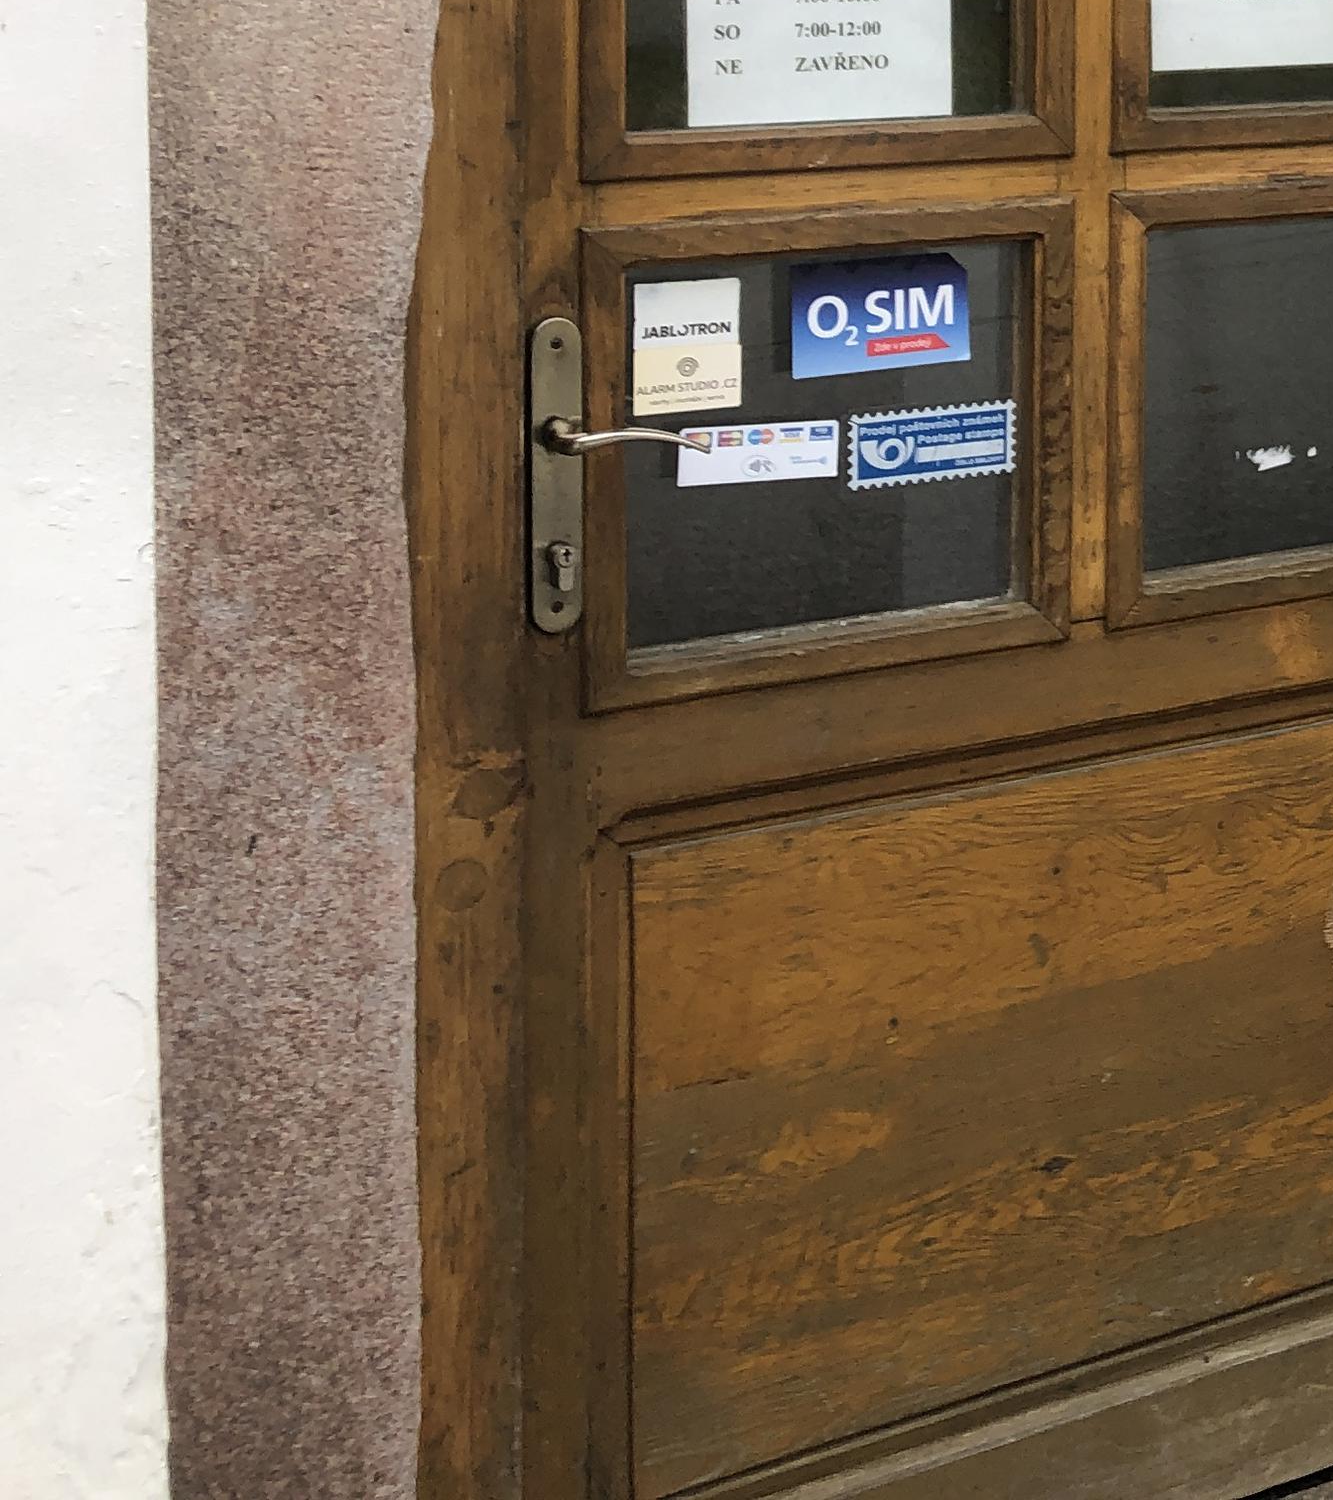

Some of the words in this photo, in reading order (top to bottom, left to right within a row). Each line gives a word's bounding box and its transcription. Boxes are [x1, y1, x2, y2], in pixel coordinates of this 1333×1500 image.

[713, 24, 741, 40] SO
[794, 21, 881, 38] 7:00-12:00
[714, 59, 742, 75] NE
[795, 52, 889, 73] ZAVŘENO
[864, 284, 954, 333] SIM
[642, 321, 731, 339] JABLOTRON
[636, 384, 675, 396] ALARM
[678, 380, 719, 393] STUDIO
[859, 423, 897, 436] Prodej
[917, 431, 963, 444] Postage
